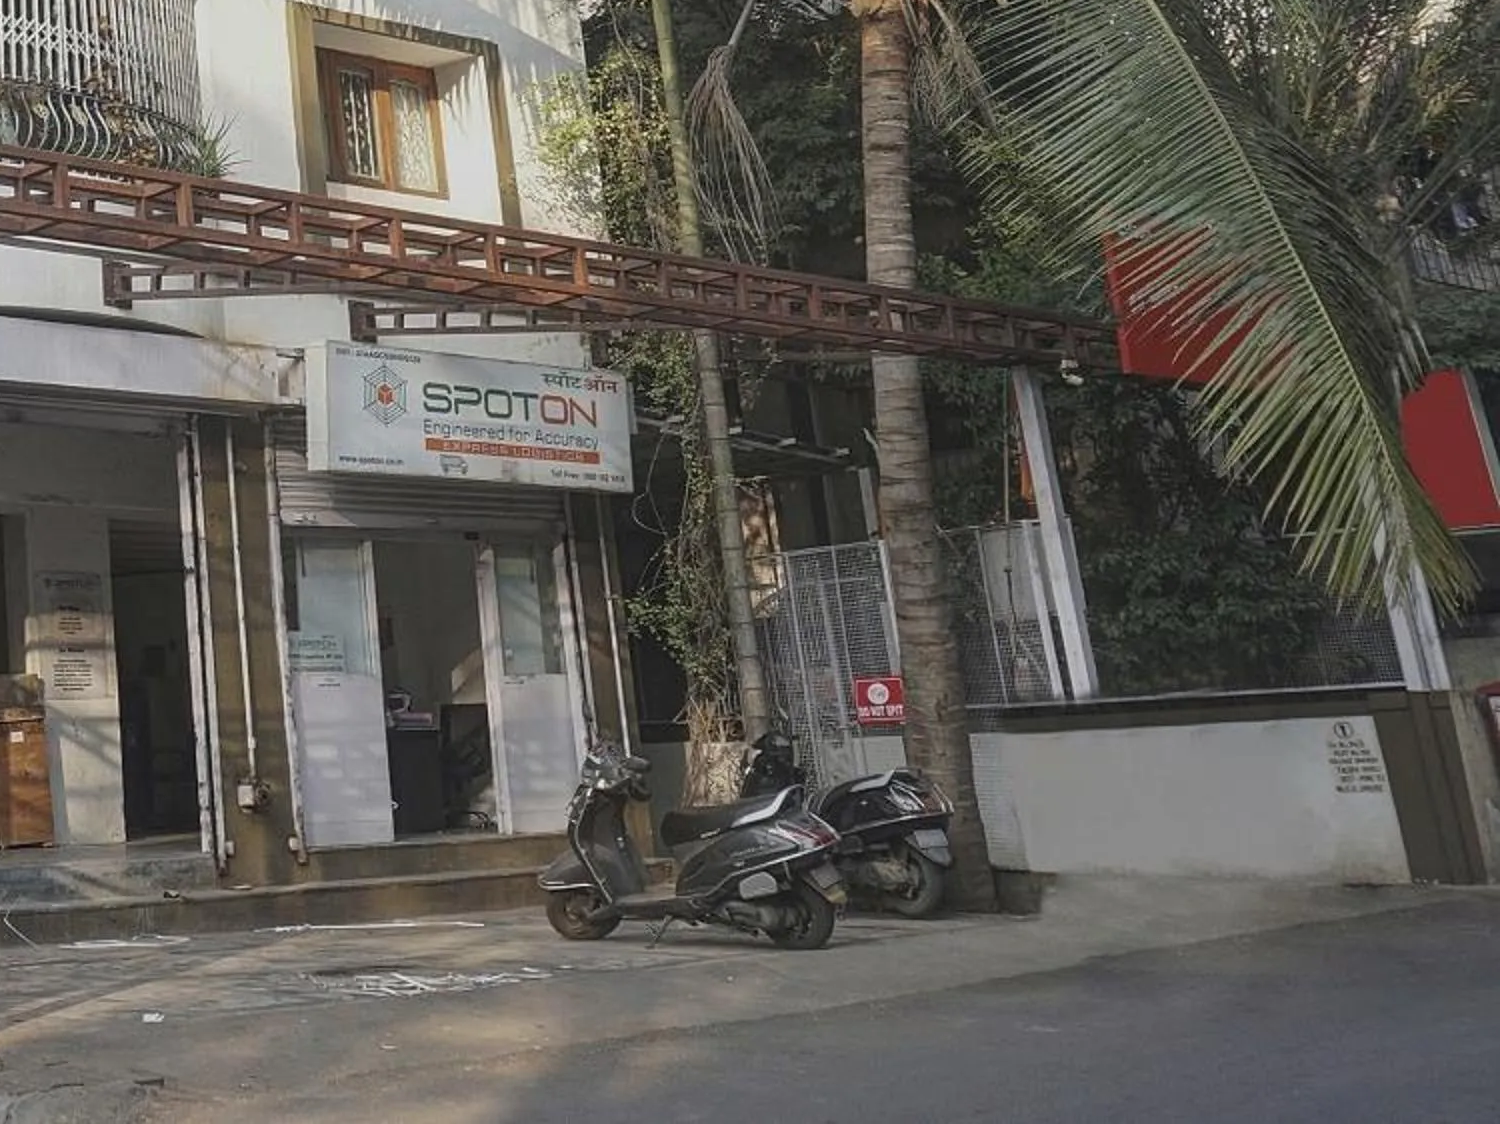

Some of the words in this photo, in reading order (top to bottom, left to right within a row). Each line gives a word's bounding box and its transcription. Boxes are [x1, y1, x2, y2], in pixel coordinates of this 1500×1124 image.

[423, 381, 598, 427] SPOTON
[423, 419, 505, 442] Engineered
[508, 426, 531, 443] for
[535, 430, 599, 451] Accuracy
